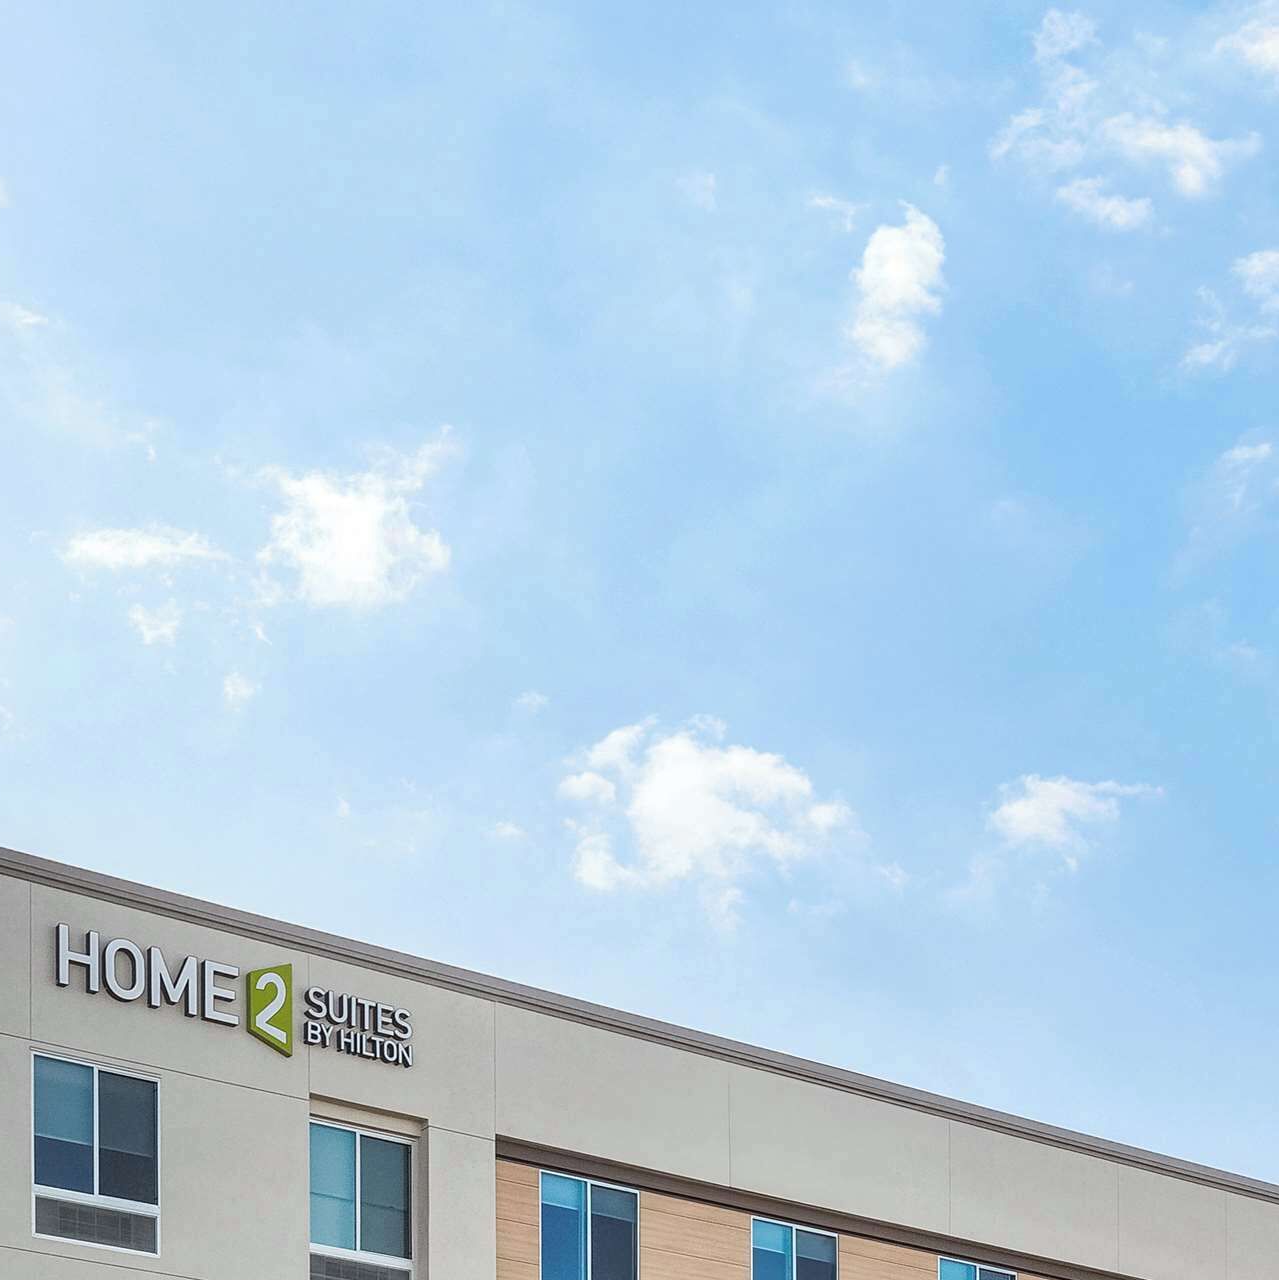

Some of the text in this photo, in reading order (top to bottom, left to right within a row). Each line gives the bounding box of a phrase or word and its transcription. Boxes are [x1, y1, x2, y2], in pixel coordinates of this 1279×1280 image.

[56, 922, 288, 1044] HOME 2
[305, 986, 413, 1040] SUITES
[304, 1021, 413, 1067] BY HILTON
